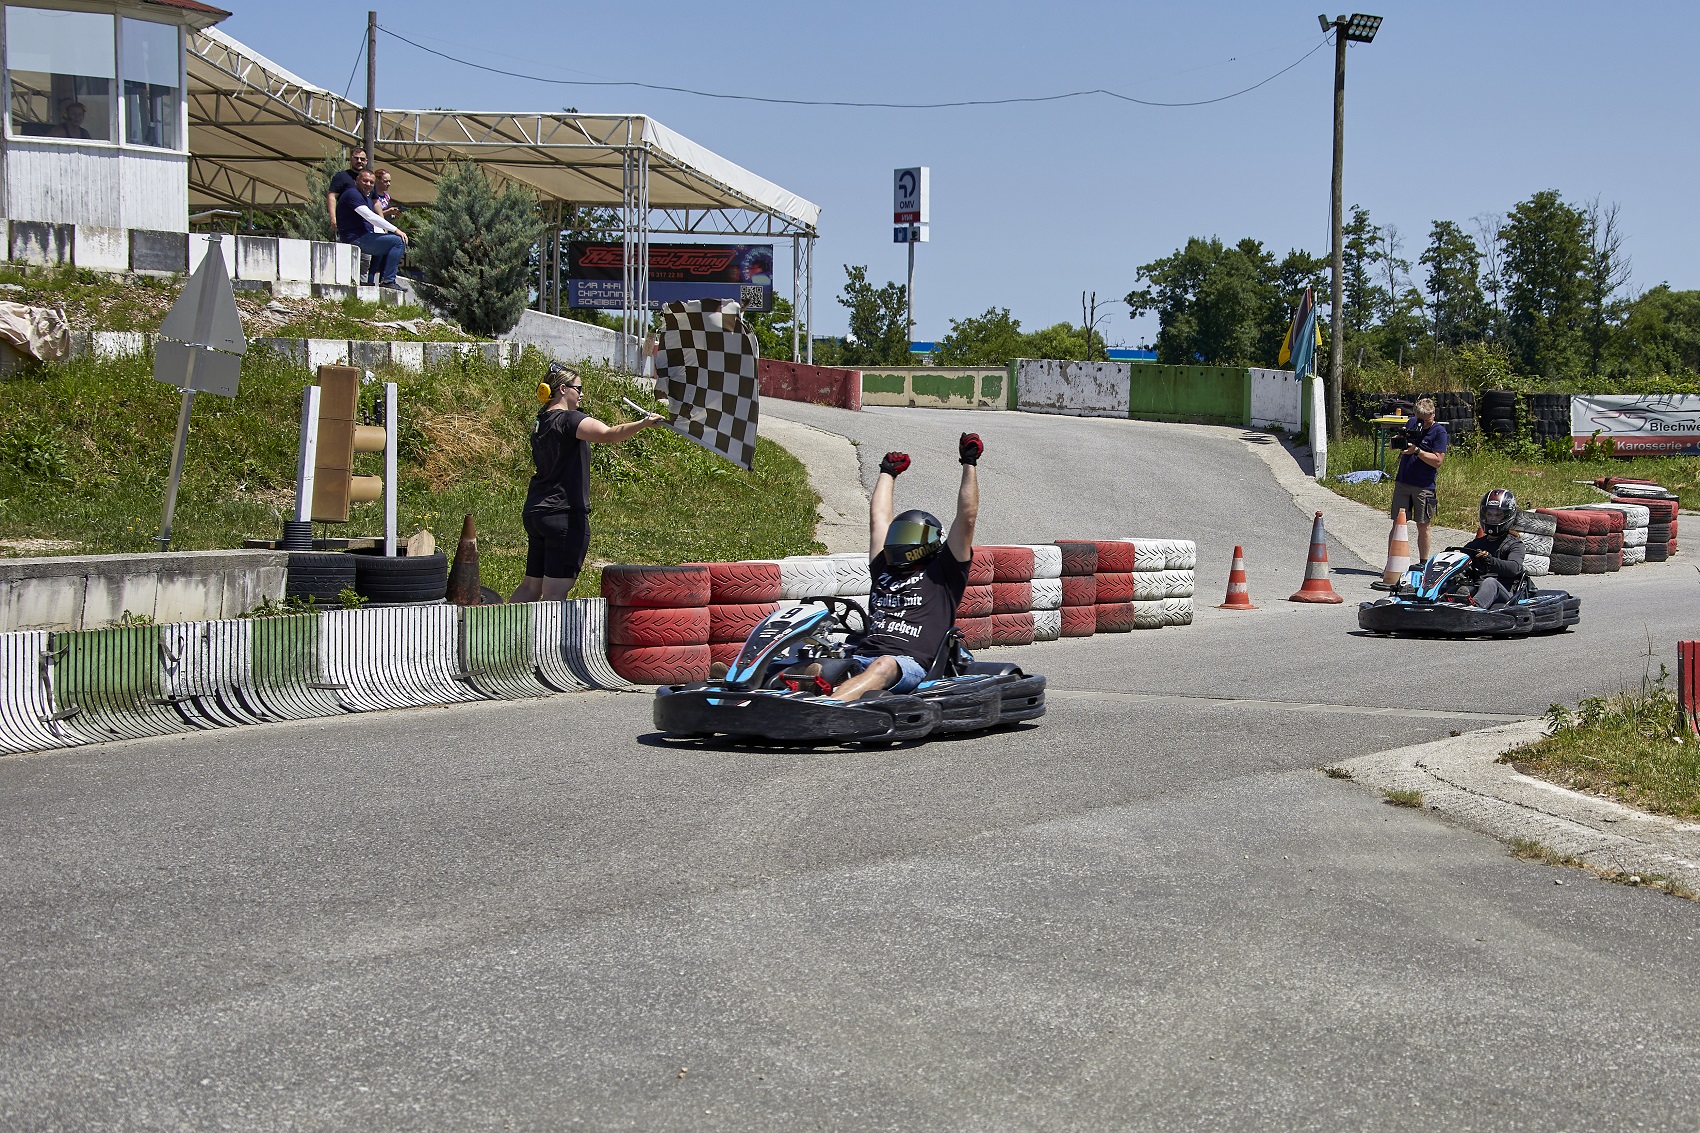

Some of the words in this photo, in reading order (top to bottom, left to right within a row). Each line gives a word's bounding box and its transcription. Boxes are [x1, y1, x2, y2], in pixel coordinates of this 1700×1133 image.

[900, 200, 915, 209] OMV
[577, 281, 598, 289] CAR
[1617, 441, 1682, 451] Karosserie
[780, 607, 804, 620] 9
[886, 620, 923, 638] gehen!
